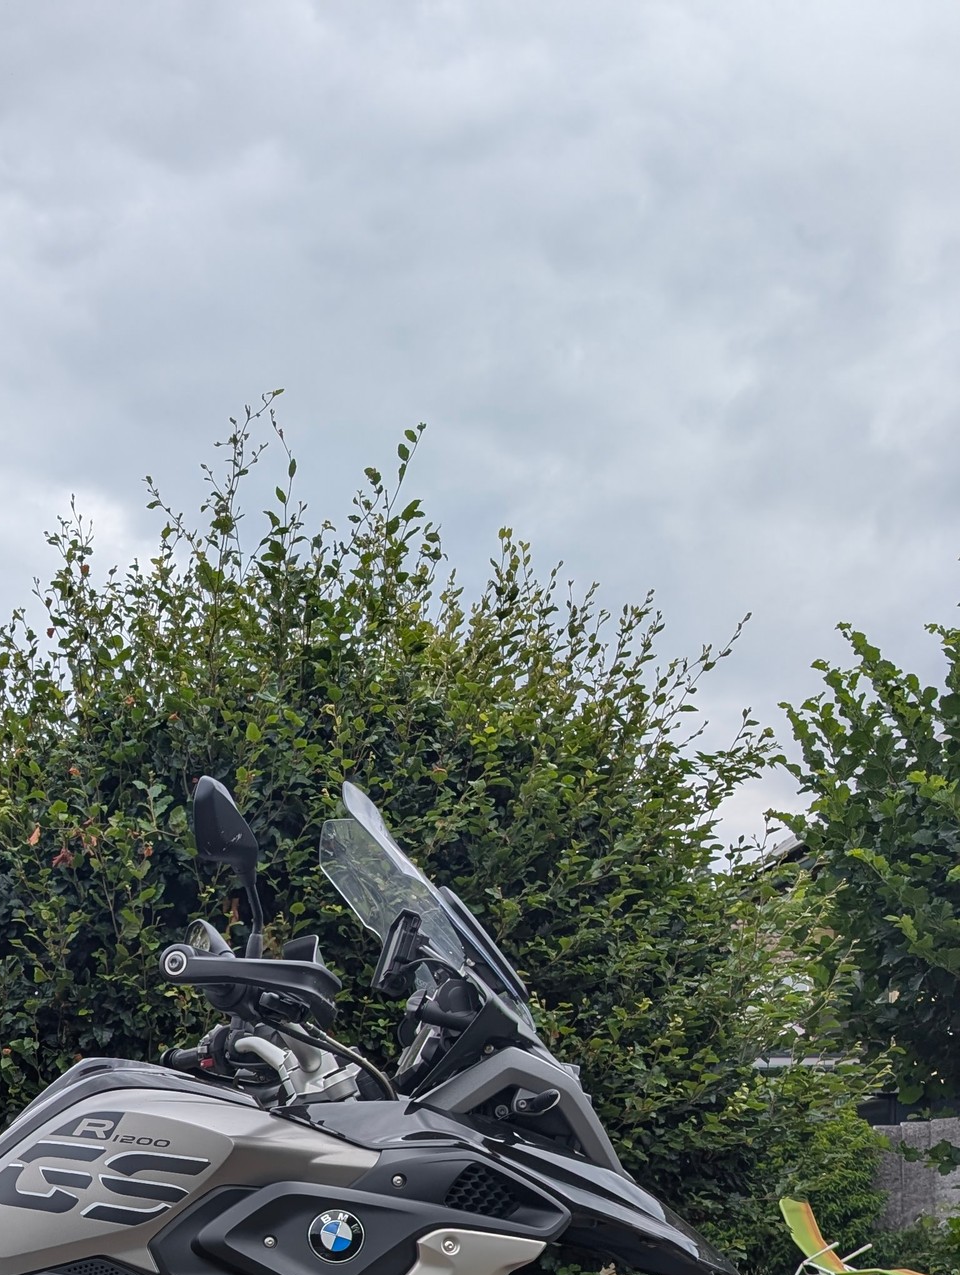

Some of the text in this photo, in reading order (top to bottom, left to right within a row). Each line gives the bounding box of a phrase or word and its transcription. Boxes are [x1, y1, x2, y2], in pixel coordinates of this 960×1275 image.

[72, 1118, 171, 1149] R 1200
[321, 1212, 361, 1234] BMW
